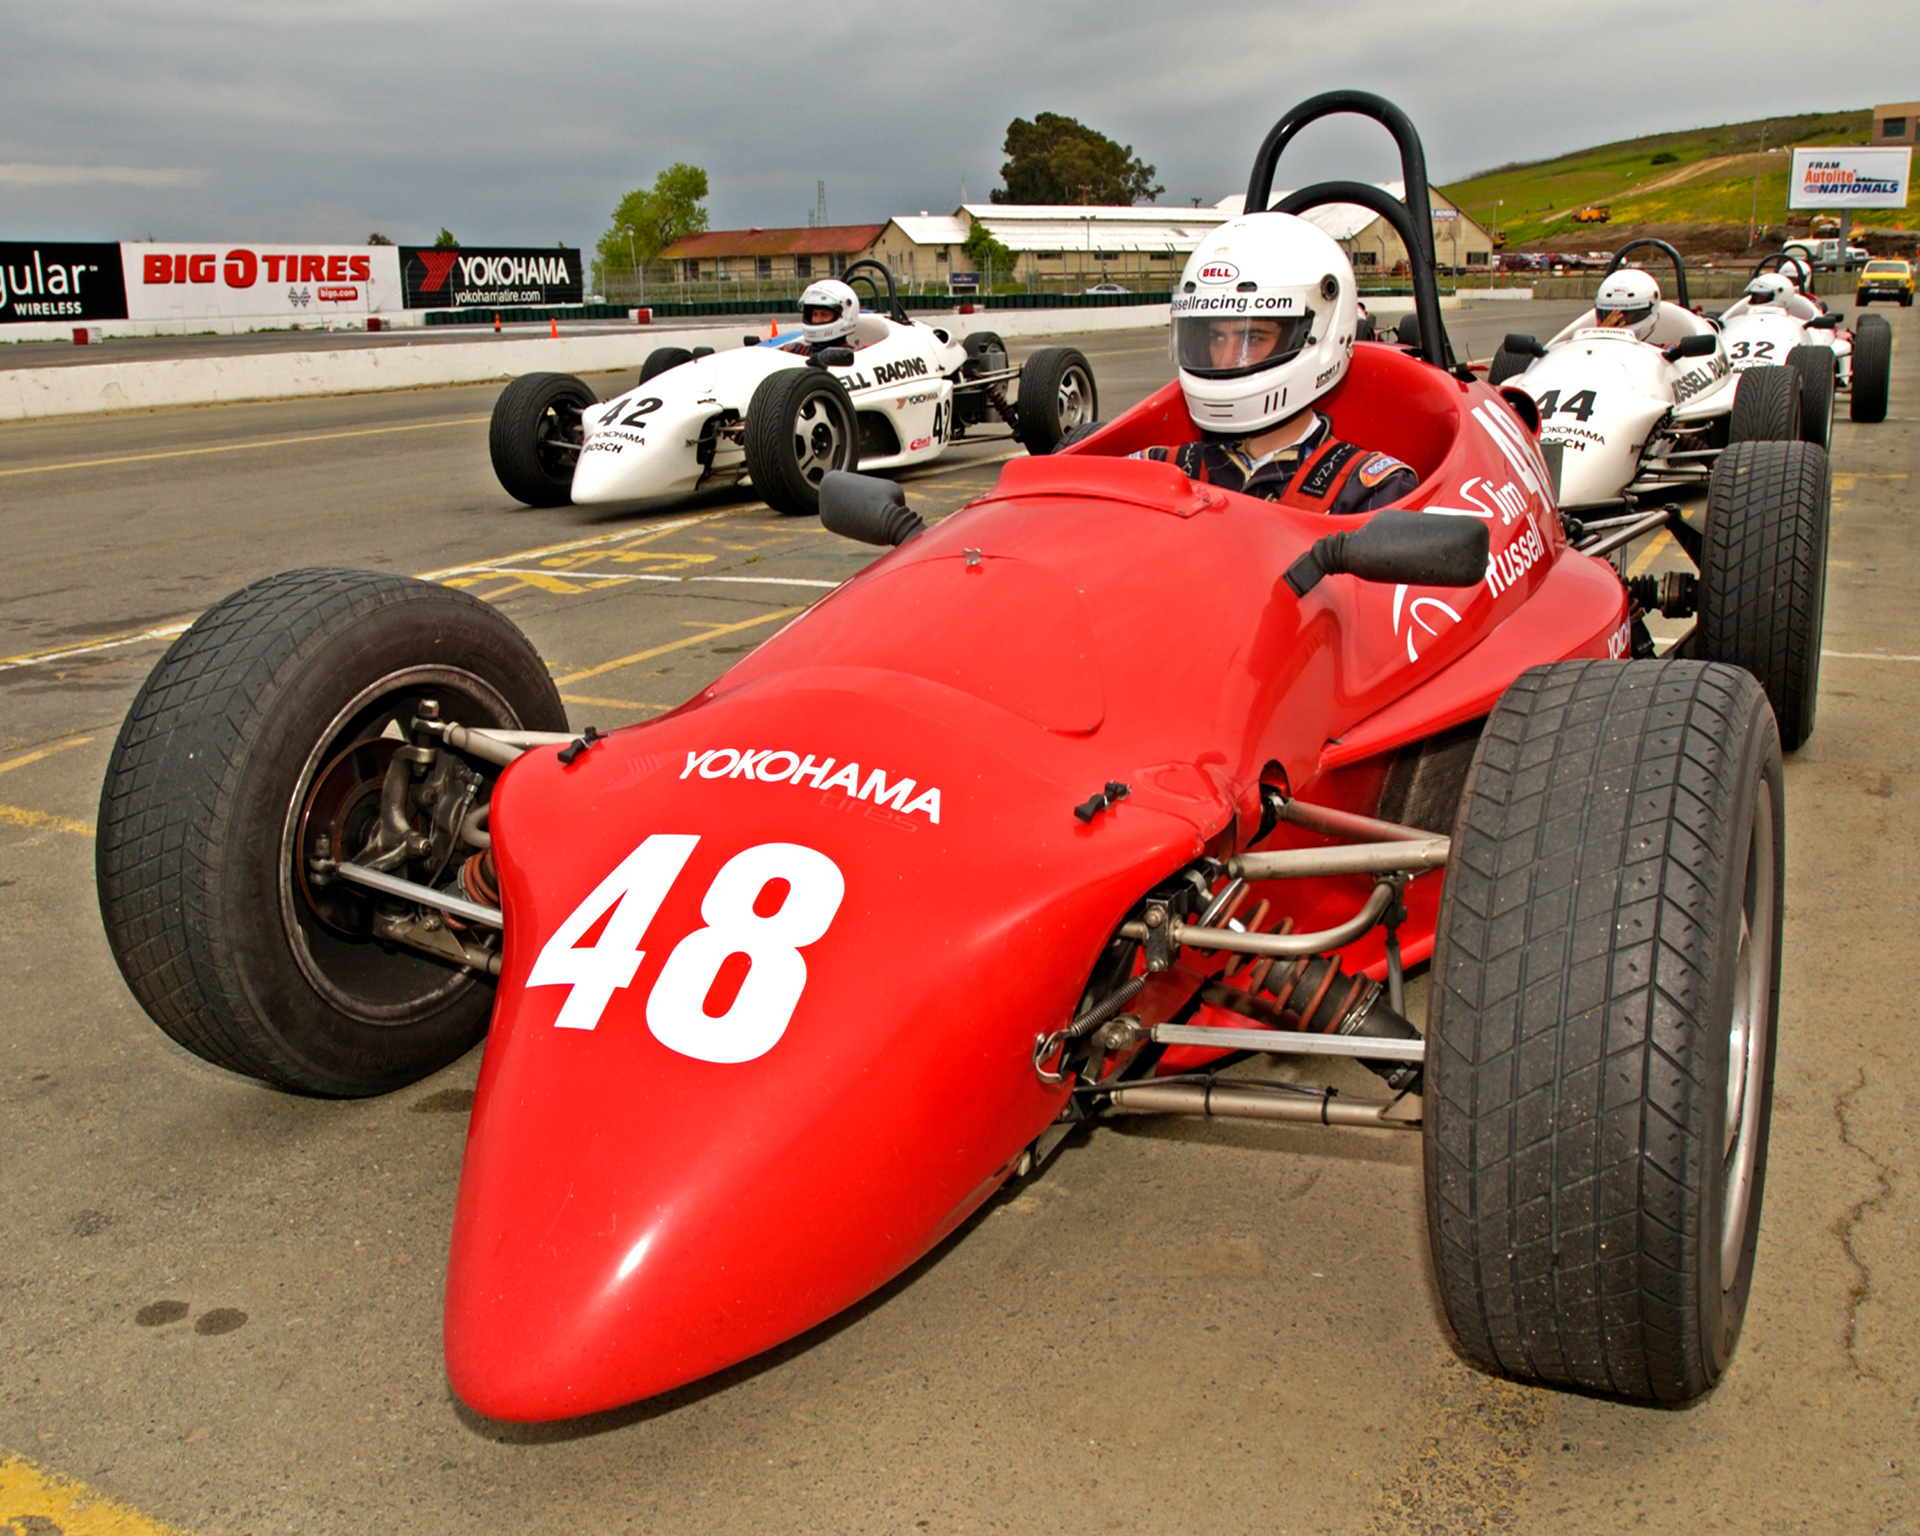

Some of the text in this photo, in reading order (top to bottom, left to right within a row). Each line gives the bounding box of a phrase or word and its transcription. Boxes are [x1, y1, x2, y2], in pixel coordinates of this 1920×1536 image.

[1804, 169, 1853, 184] Autolite
[1808, 161, 1840, 169] FRAM
[1818, 183, 1899, 194] NATIONALS
[143, 249, 370, 289] BIG O TIRES
[457, 256, 570, 286] YOKOHAMA
[1202, 268, 1231, 278] BELL
[14, 301, 82, 316] WIRELESS
[320, 288, 356, 299] bigo.com
[455, 289, 541, 306] yokohamatire.com
[1730, 341, 1775, 360] 32
[872, 356, 928, 386] RACING
[597, 397, 664, 429] 42
[1536, 389, 1597, 423] 44
[932, 399, 951, 445] 42
[1481, 479, 1528, 526] Jim
[1485, 512, 1546, 599] Russell
[679, 748, 942, 825] YOKOHAMA
[525, 833, 846, 1065] 48
